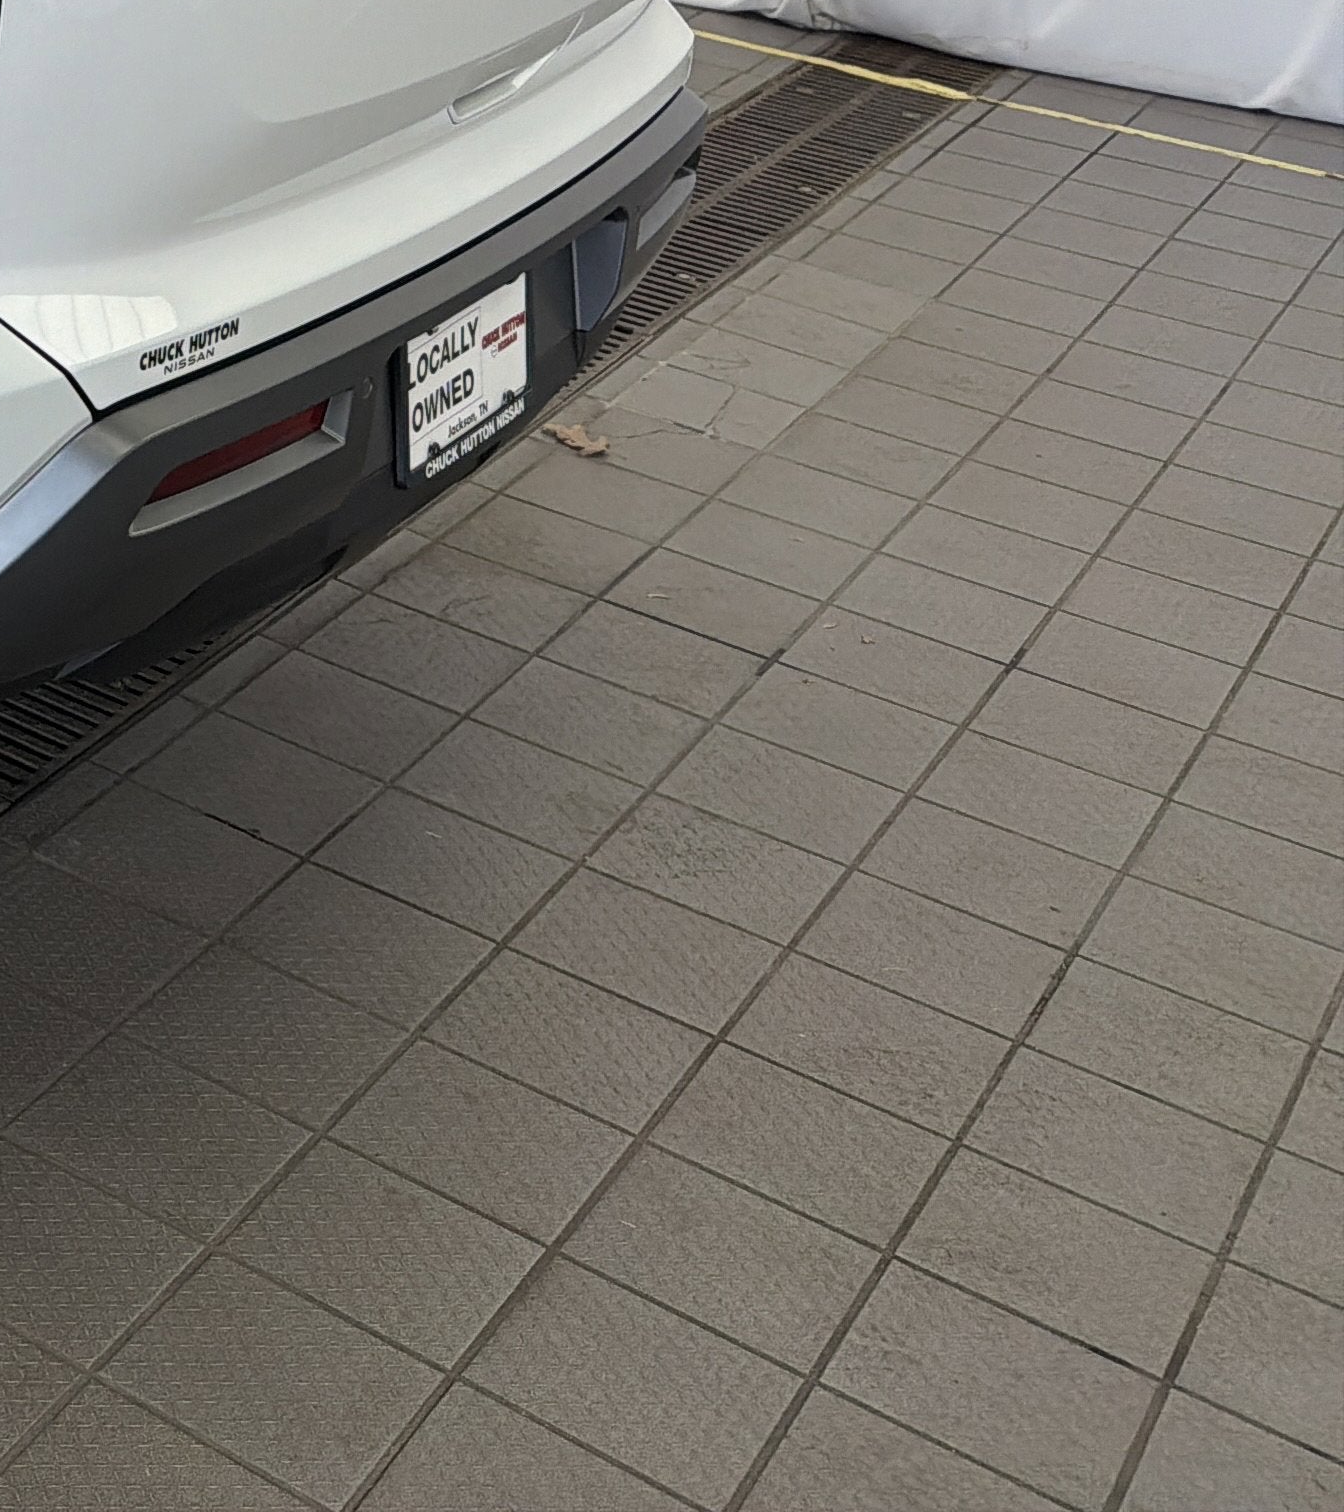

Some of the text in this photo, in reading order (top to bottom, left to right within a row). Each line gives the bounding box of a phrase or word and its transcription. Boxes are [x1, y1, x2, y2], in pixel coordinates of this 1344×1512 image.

[139, 317, 240, 371] CHUCK HUTTON
[163, 347, 215, 375] NISSAN
[409, 317, 479, 389] LOCALLY
[412, 368, 475, 433] OWNED
[425, 397, 526, 478] CHUCK HUTTON NISSAN
